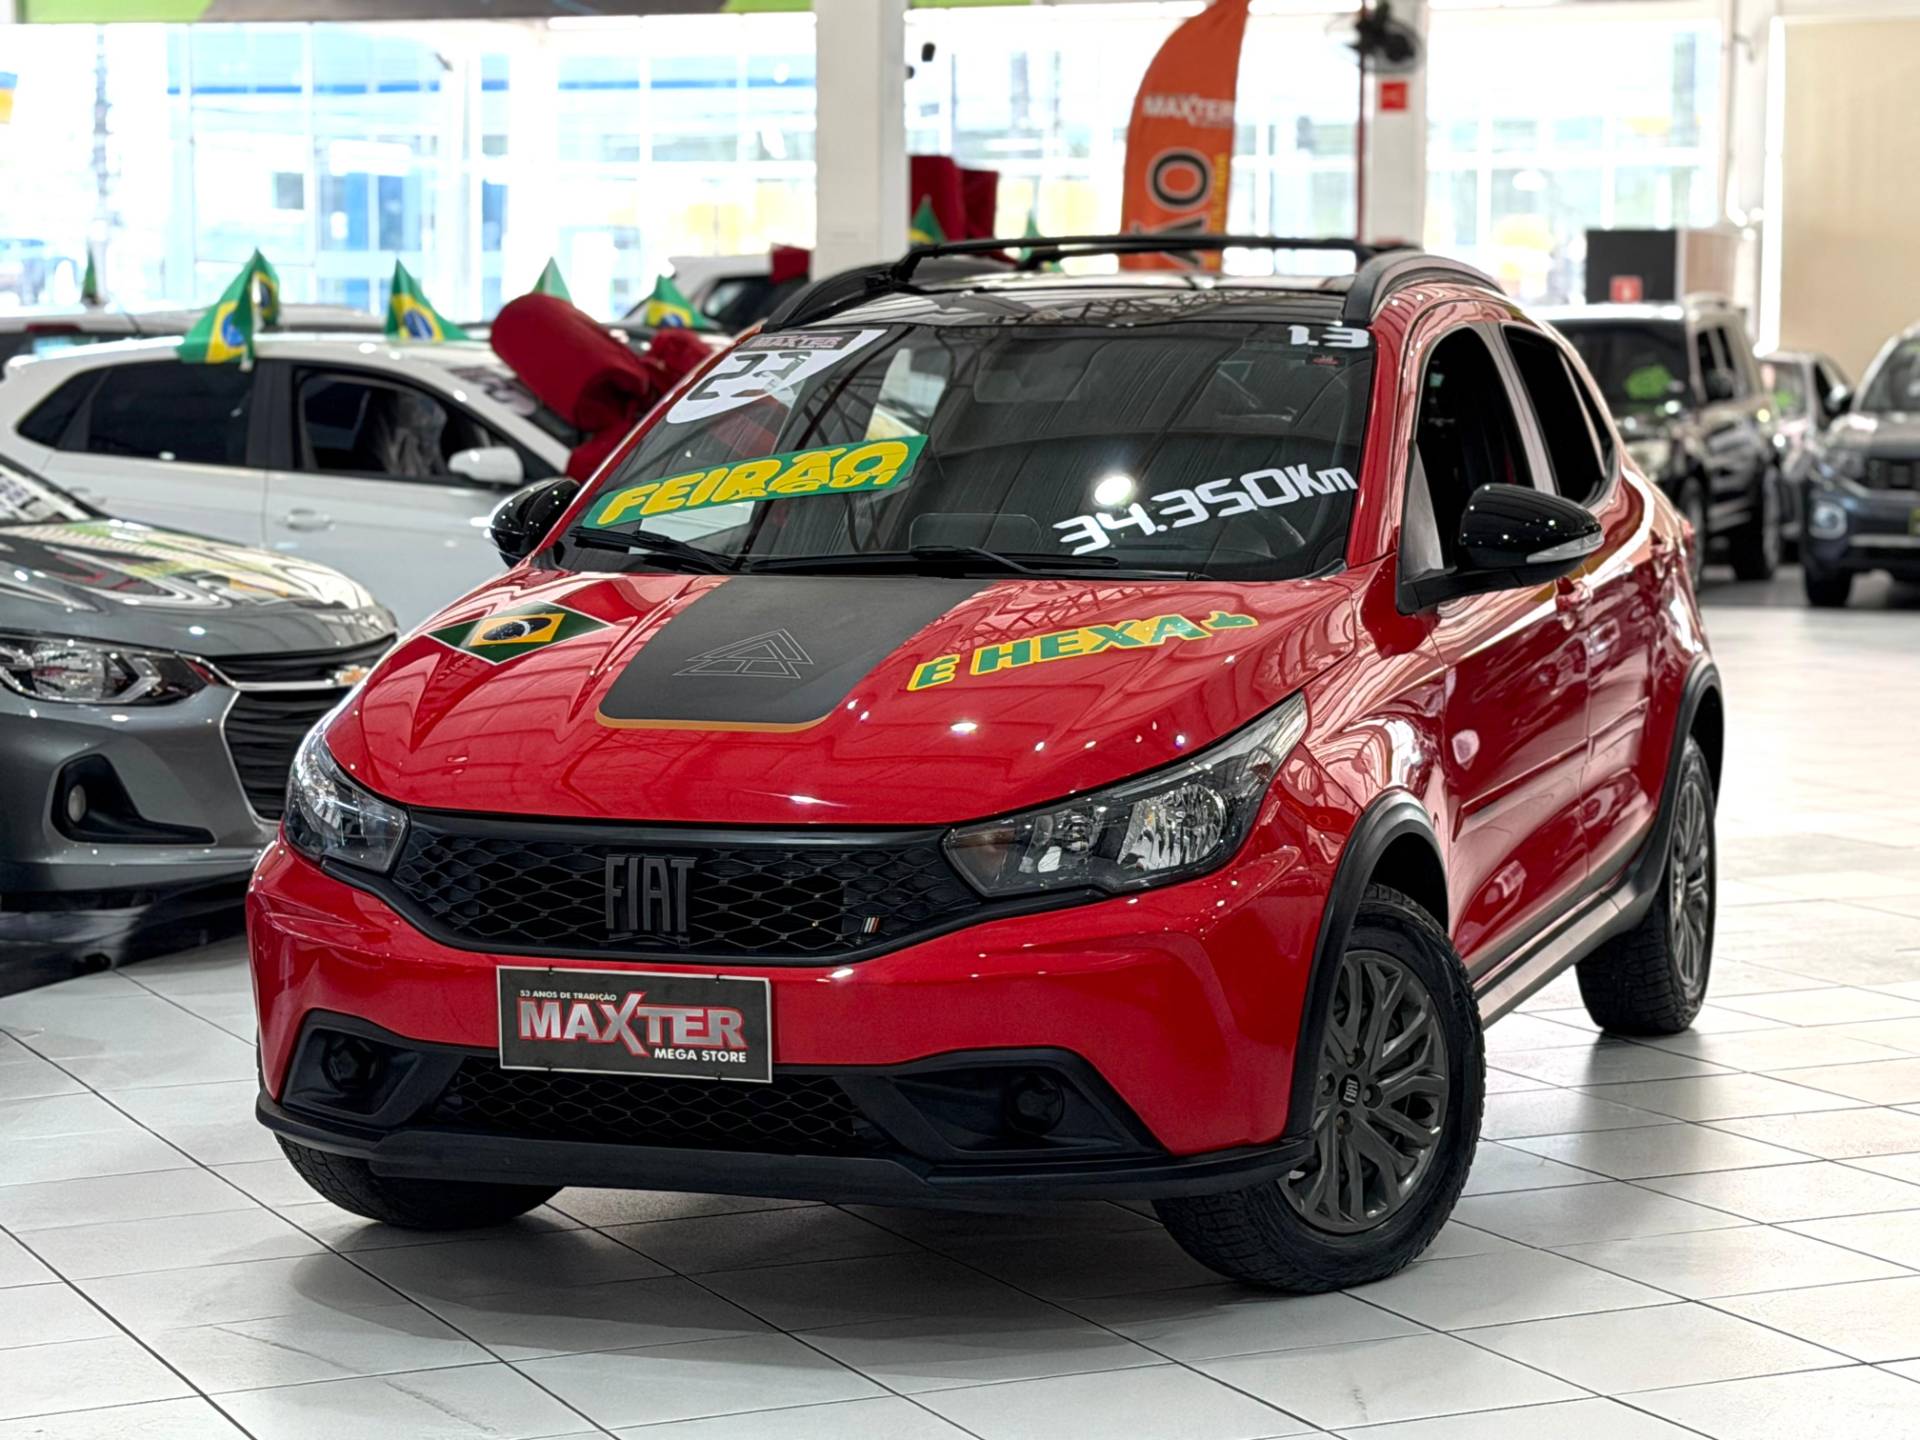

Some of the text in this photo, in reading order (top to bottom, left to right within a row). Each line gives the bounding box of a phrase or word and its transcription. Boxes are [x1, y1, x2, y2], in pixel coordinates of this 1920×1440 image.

[1287, 325, 1370, 348] 1.3
[597, 441, 909, 525] FEIRÃO
[1052, 464, 1358, 555] 34.350Km
[969, 613, 1212, 675] HEXA
[605, 854, 697, 932] FIAT
[518, 991, 748, 1056] MAXTER
[533, 990, 557, 998] ANOS
[573, 992, 617, 1001] TRADIÇÃO
[654, 1049, 747, 1062] MEGA STORE
[1343, 1078, 1358, 1103] FIAT
